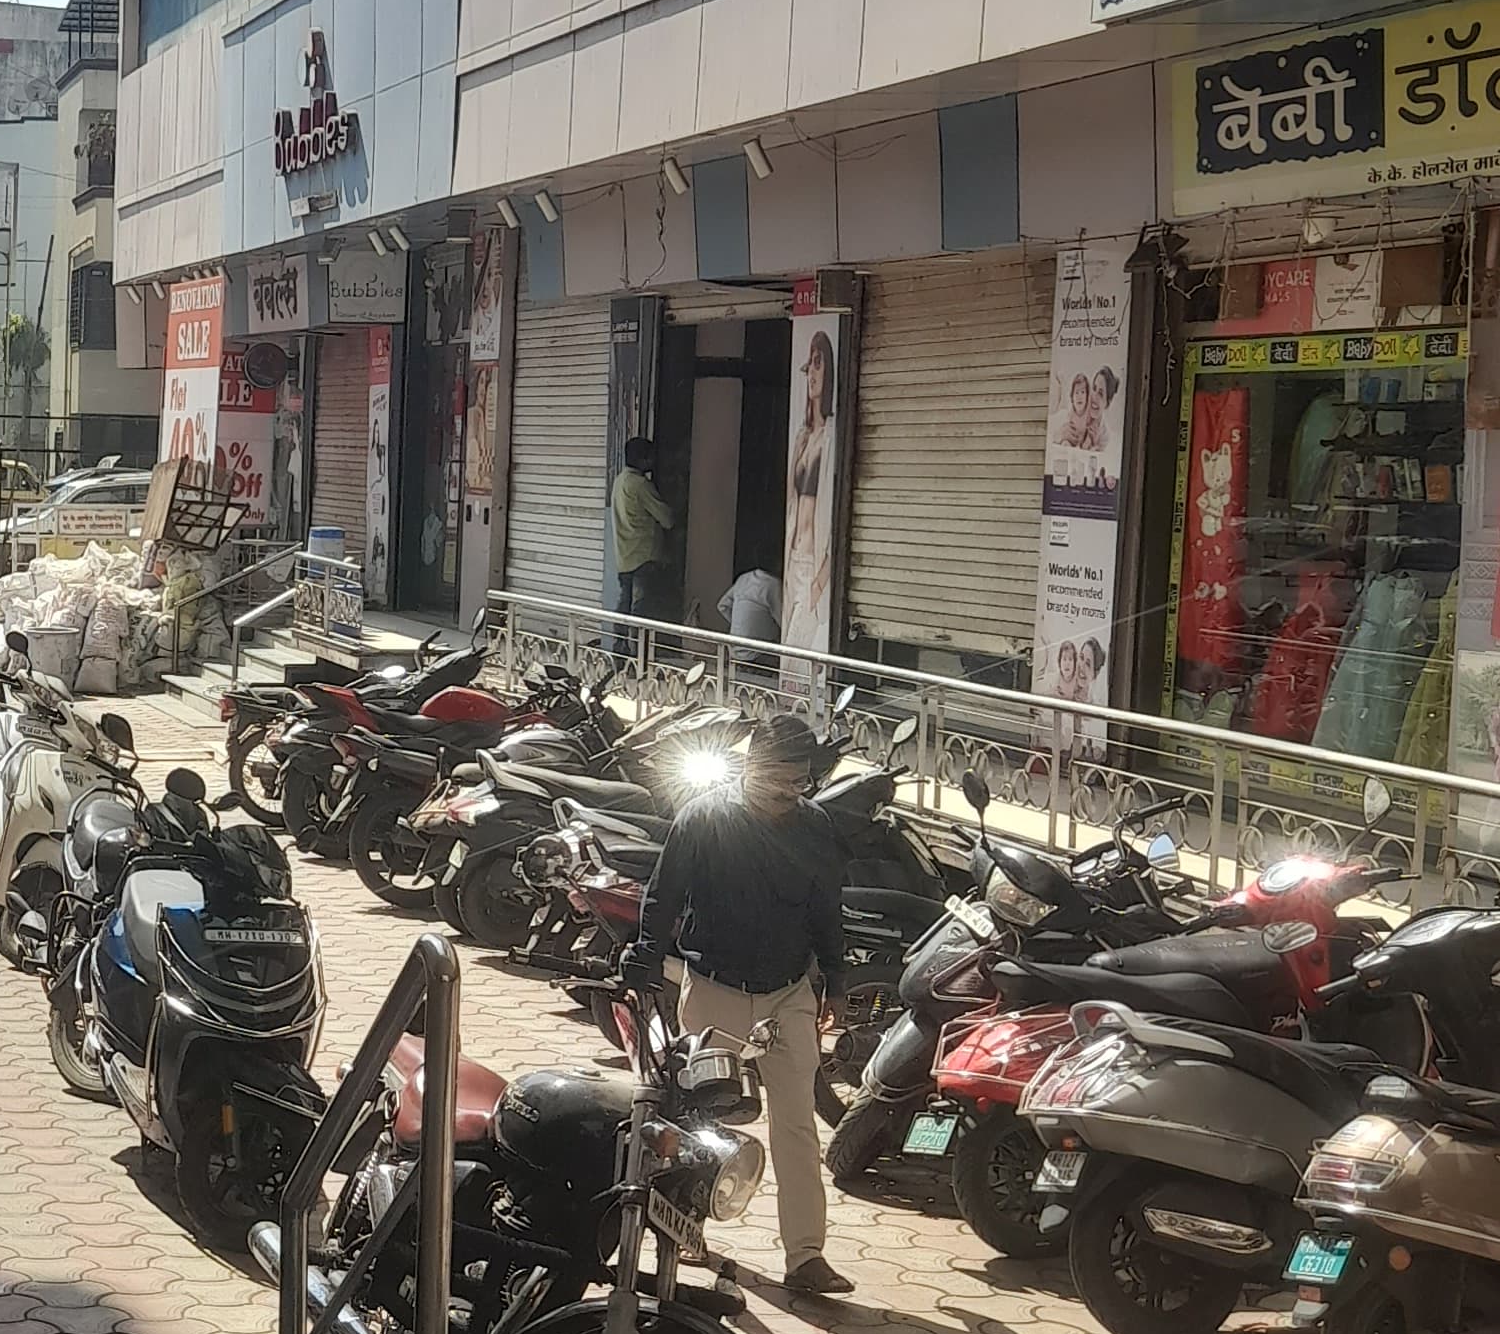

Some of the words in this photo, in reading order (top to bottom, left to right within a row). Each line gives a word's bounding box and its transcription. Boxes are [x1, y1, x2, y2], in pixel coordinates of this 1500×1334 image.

[1211, 56, 1357, 155] बेबी
[274, 91, 348, 176] Bubbles
[329, 273, 403, 299] Bubbles
[1264, 269, 1312, 288] YCARE
[170, 282, 222, 314] RENOVATION
[176, 319, 211, 360] SALE
[169, 377, 187, 412] Flat
[220, 378, 253, 407] LE
[231, 472, 263, 498] Off
[1084, 568, 1103, 582] No.1
[1047, 598, 1069, 614] brand
